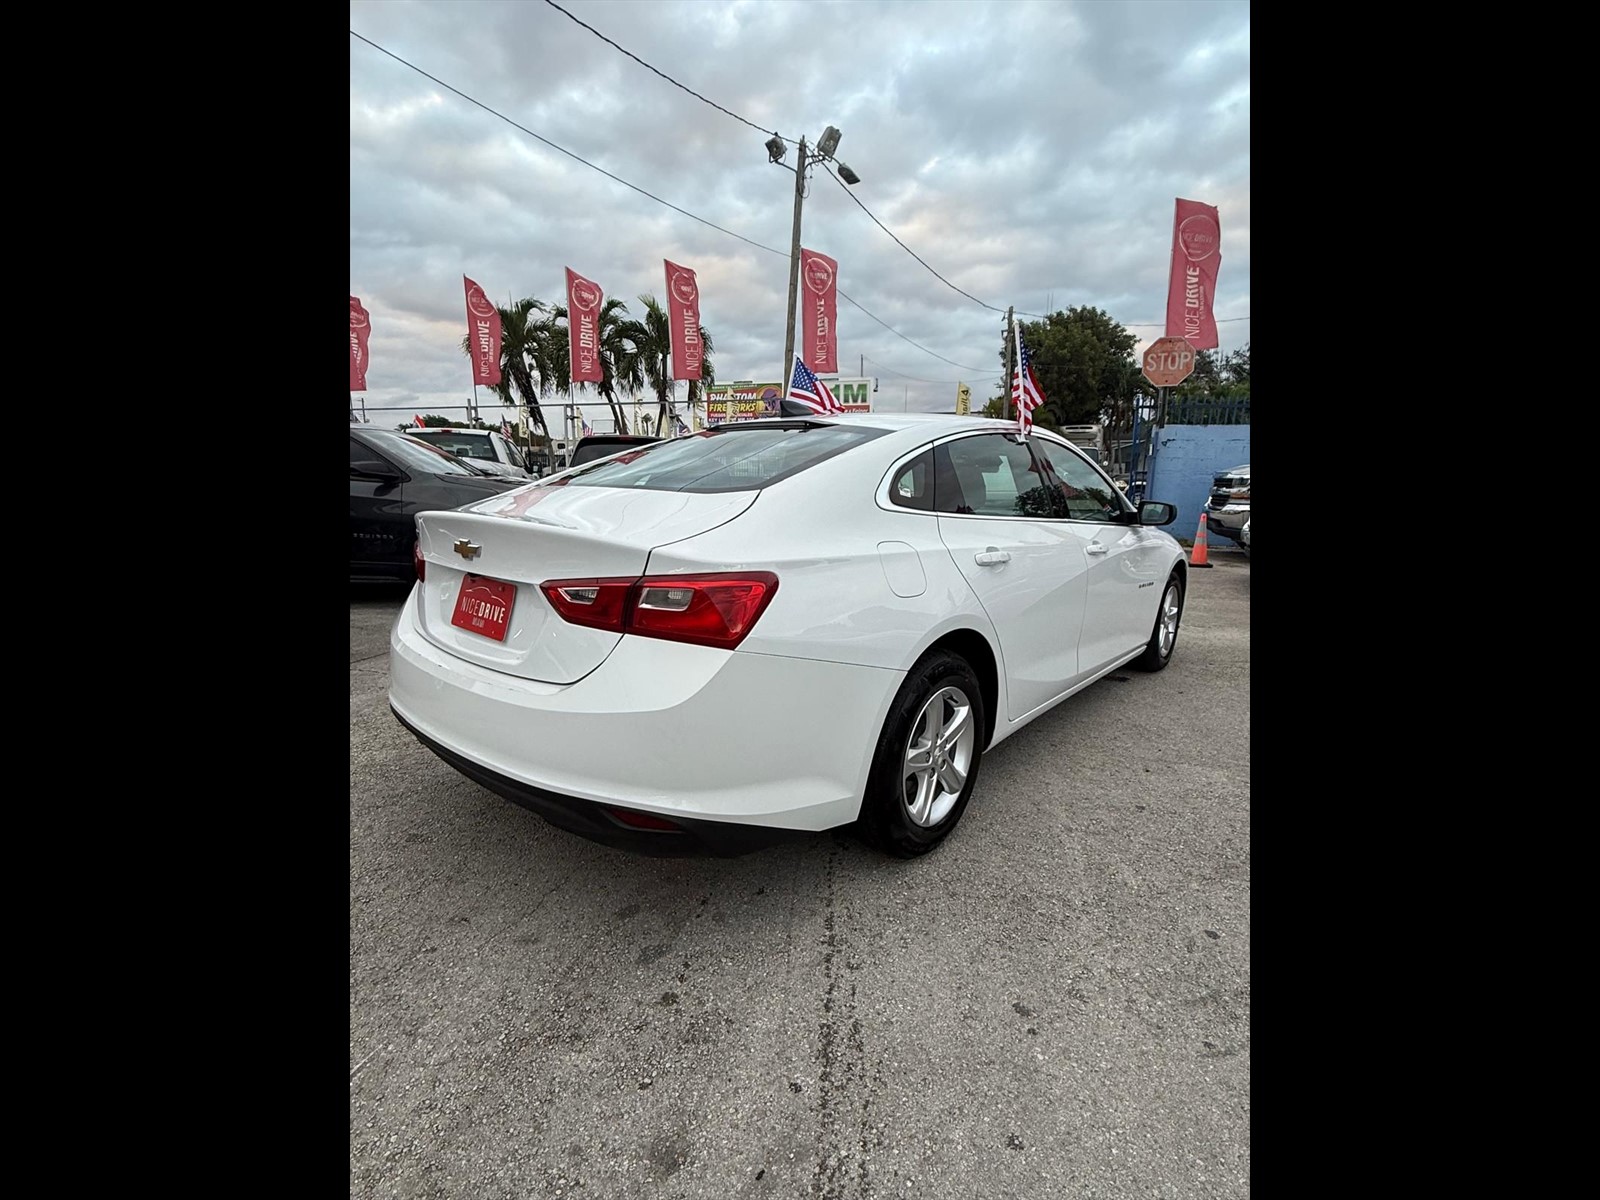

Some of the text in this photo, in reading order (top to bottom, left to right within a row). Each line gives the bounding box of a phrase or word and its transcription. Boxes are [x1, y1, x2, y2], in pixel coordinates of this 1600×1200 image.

[1185, 265, 1200, 339] NICE DRIVE
[579, 314, 594, 373] NICE DRIVE
[684, 308, 698, 344] DRIVE
[477, 320, 490, 377] NICE DRIVE
[686, 346, 699, 371] NICE
[815, 338, 827, 364] NICE
[1146, 351, 1191, 371] STOP
